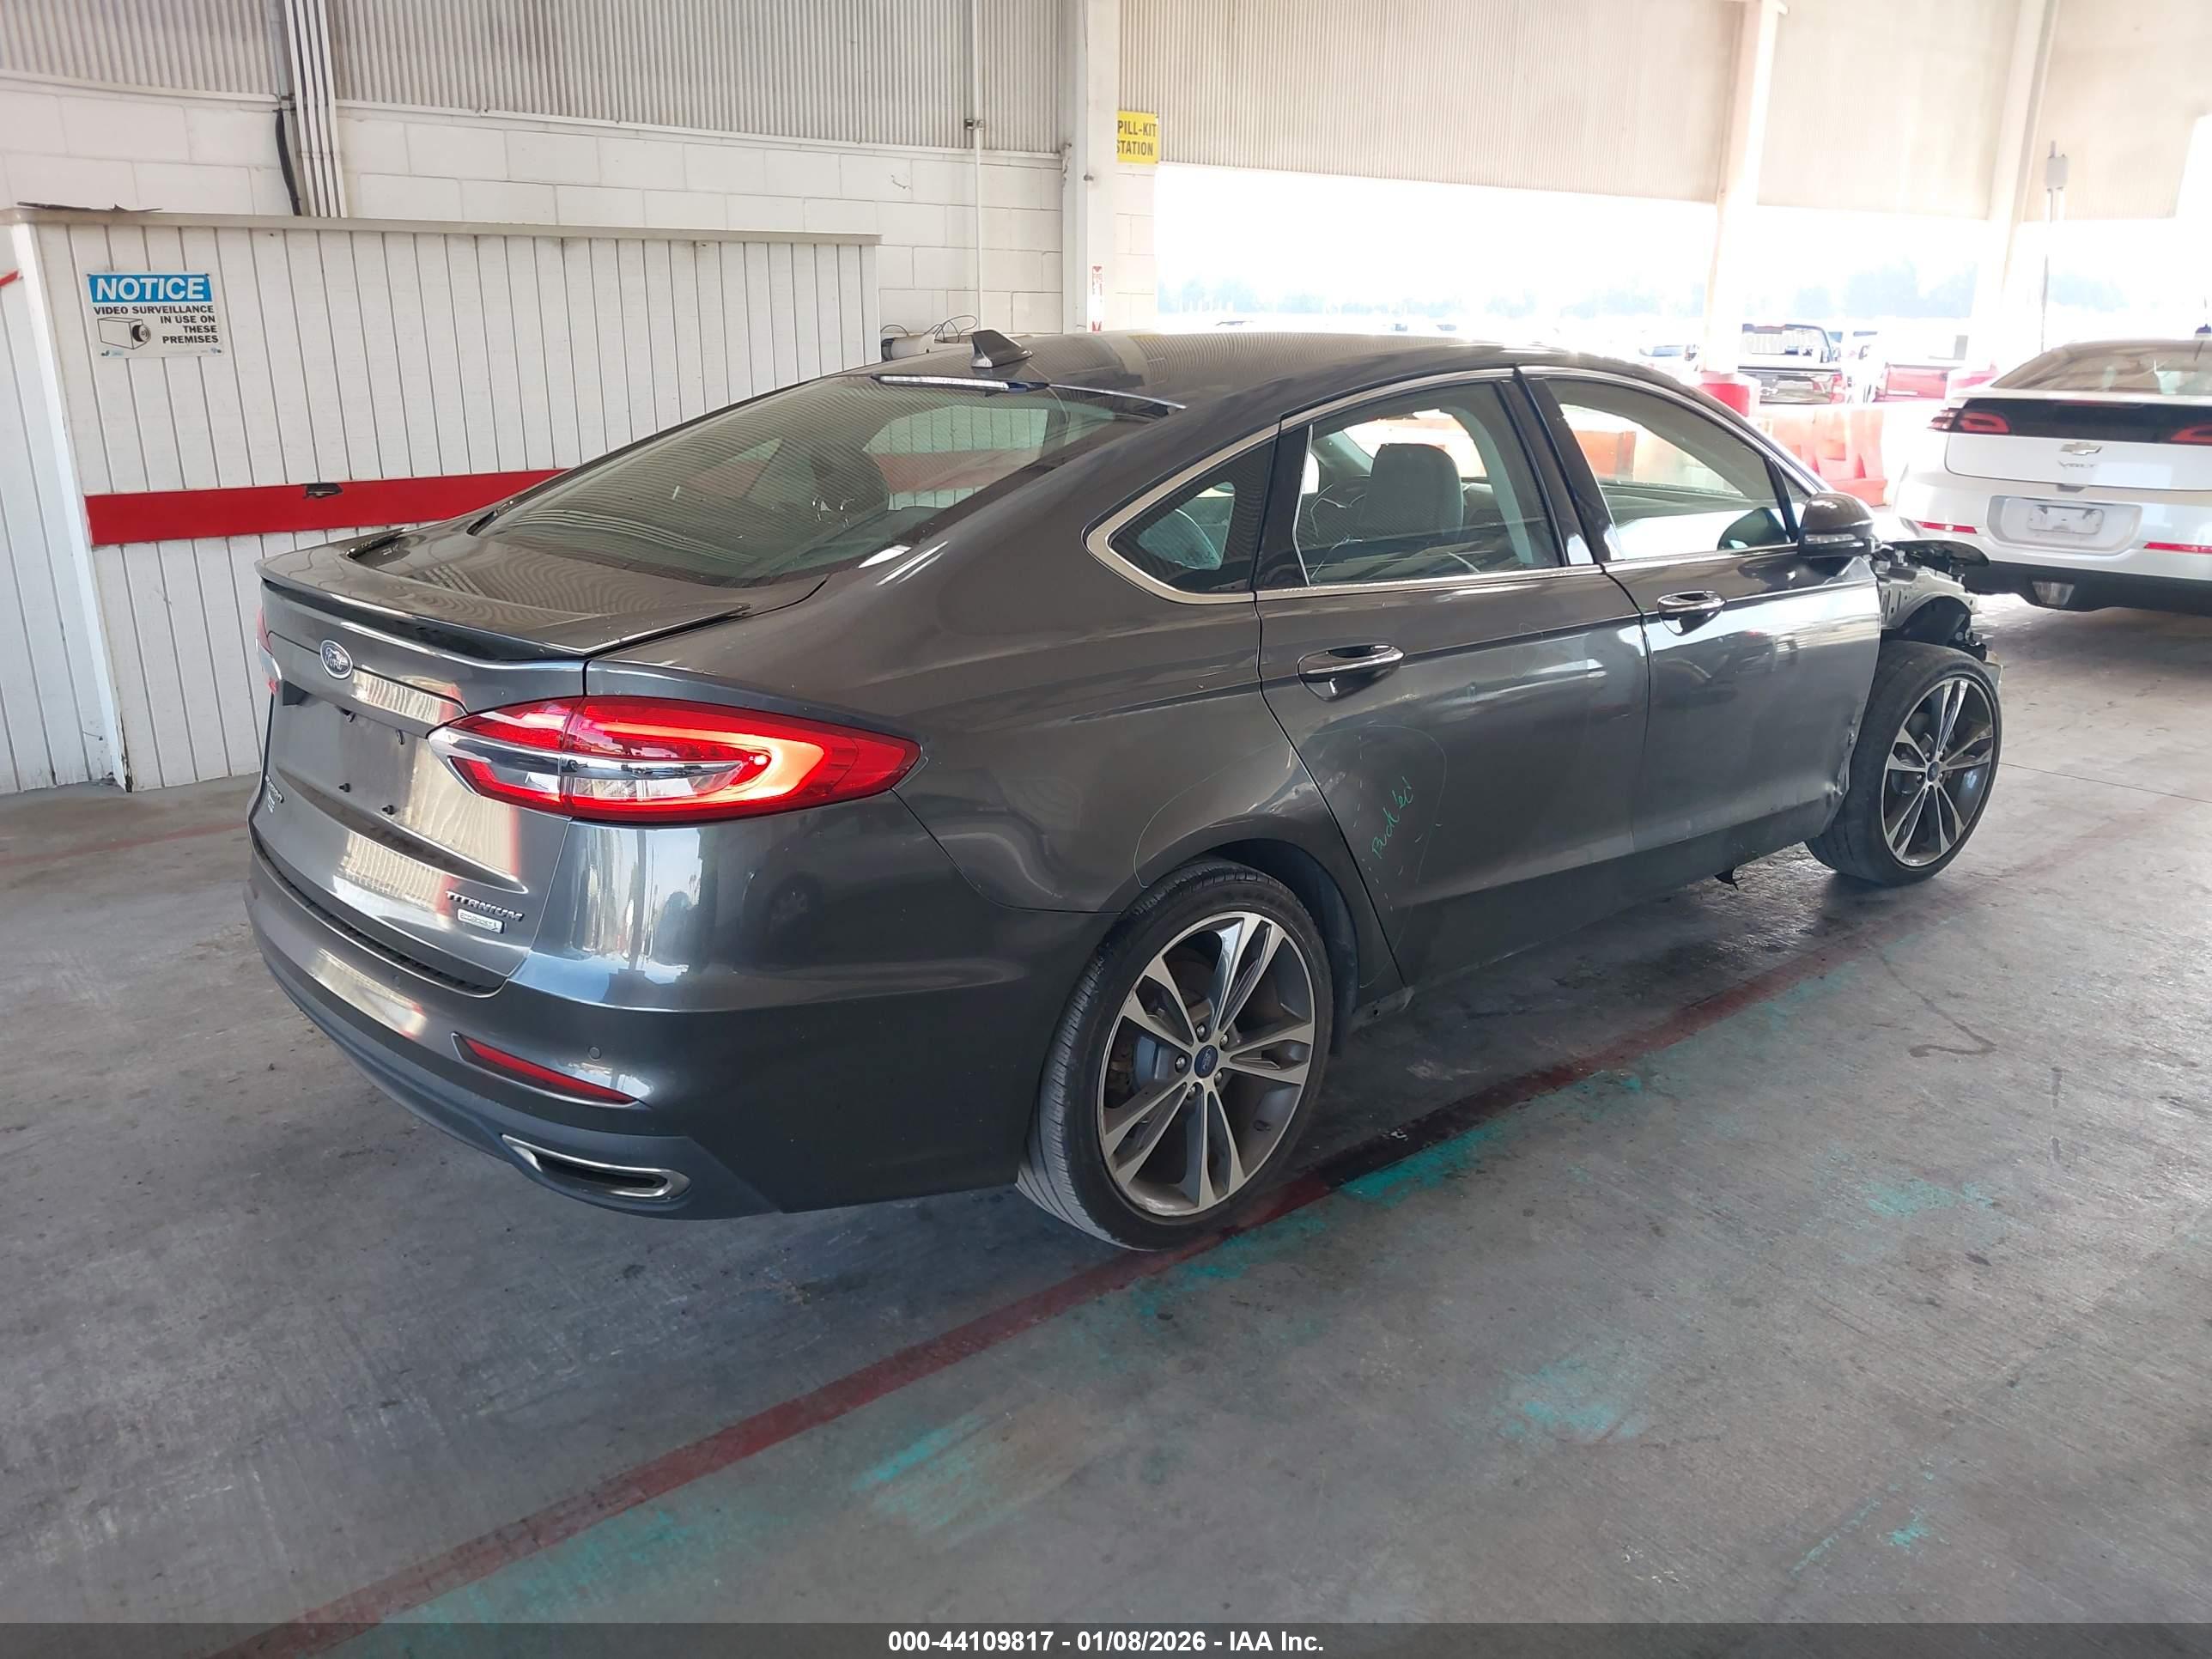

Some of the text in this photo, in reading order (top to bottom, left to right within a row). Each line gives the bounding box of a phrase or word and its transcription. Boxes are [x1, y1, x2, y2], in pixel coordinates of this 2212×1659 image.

[1117, 119, 1157, 137] PILL-KIT
[96, 277, 204, 301] NOTICE
[94, 305, 214, 315] VIDEO SURVEILLANCE
[174, 315, 197, 324] USE
[200, 315, 216, 324] ON
[183, 325, 217, 333] THESE
[162, 335, 219, 344] PREMISES
[445, 890, 525, 922] TITANIUM
